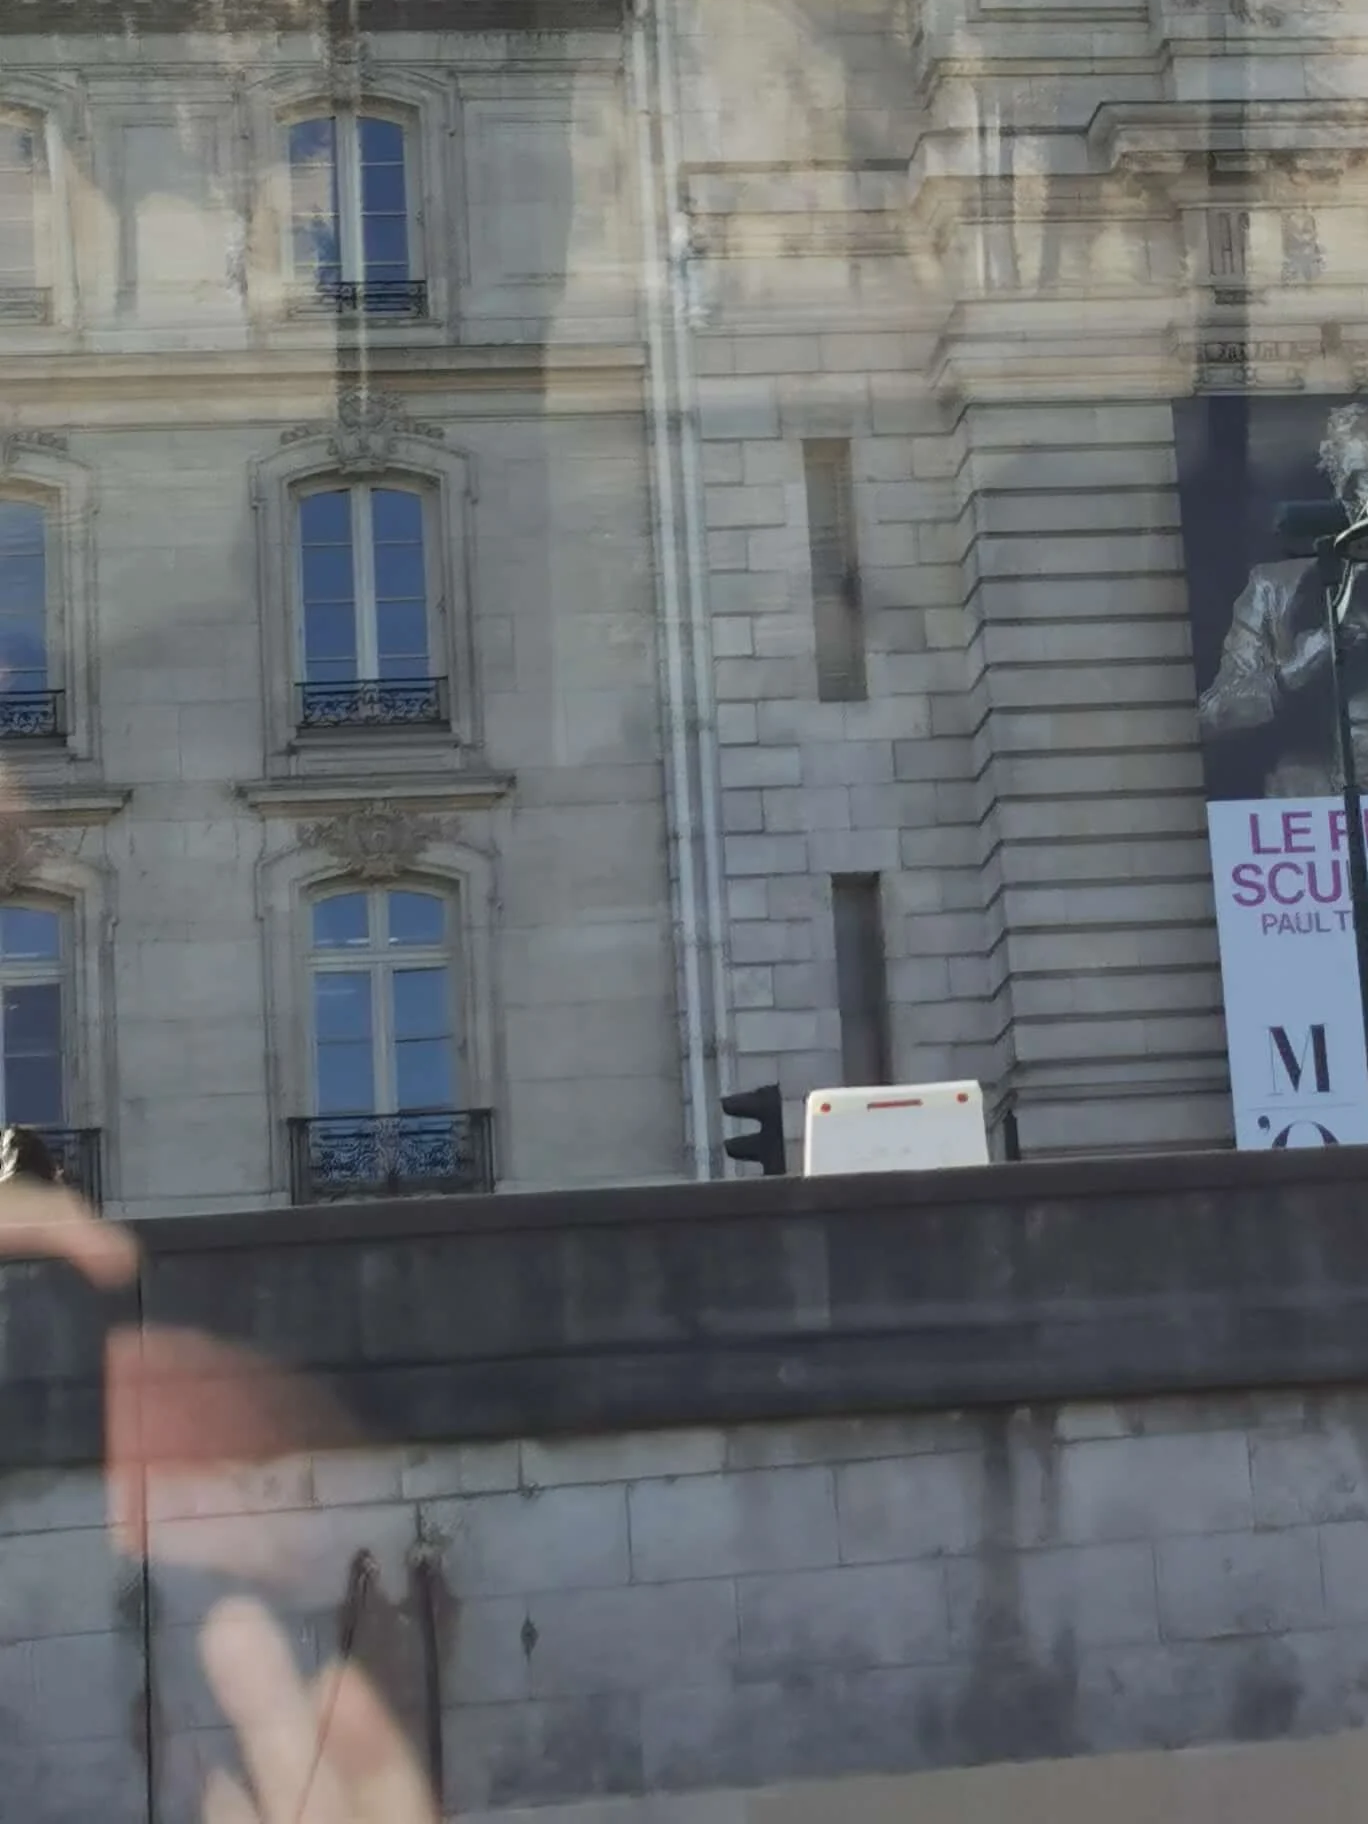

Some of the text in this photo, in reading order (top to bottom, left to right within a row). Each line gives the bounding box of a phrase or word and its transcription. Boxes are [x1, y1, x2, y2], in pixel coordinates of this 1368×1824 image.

[1249, 810, 1316, 856] LE
[1261, 910, 1332, 935] PAUL
[1266, 1022, 1337, 1096] M
